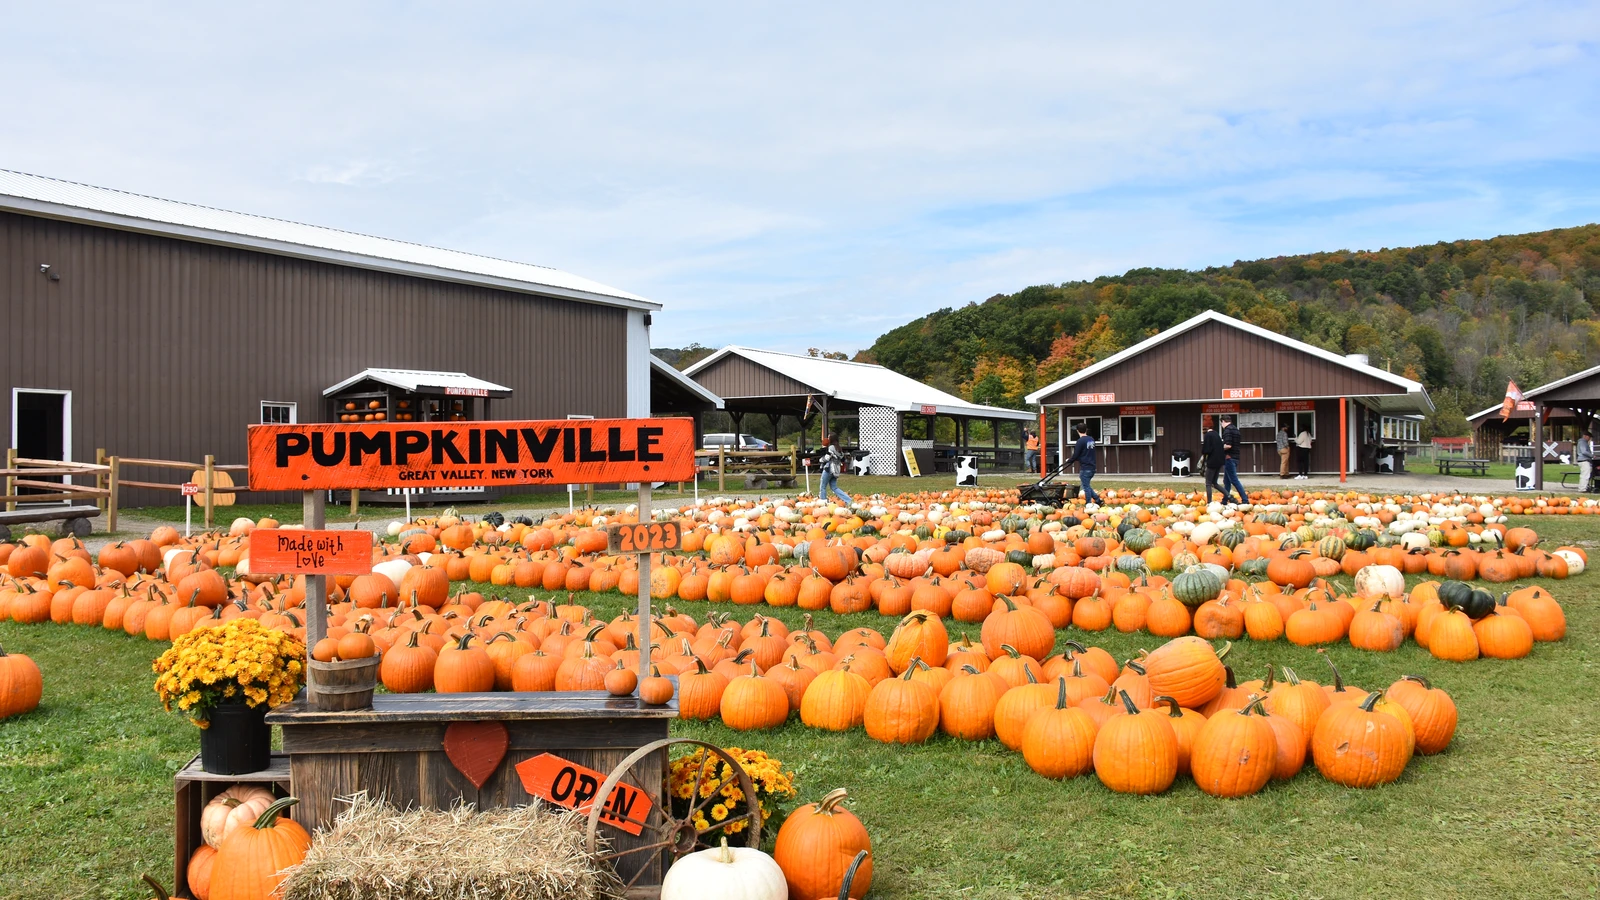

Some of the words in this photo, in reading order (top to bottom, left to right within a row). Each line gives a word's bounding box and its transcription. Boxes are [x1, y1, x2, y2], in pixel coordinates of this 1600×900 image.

[446, 387, 488, 396] PUMPKINVILLE
[1230, 390, 1242, 398] BBQ
[1244, 389, 1254, 397] PIT
[1078, 395, 1094, 403] SWEETS
[1099, 394, 1113, 402] TREATS
[276, 427, 664, 468] PUMPKINVILLE
[399, 471, 437, 481] GREAT
[492, 469, 516, 479] NEW
[522, 468, 554, 479] YORK
[619, 523, 677, 551] 2023
[277, 535, 313, 552] Made
[317, 535, 343, 555] with
